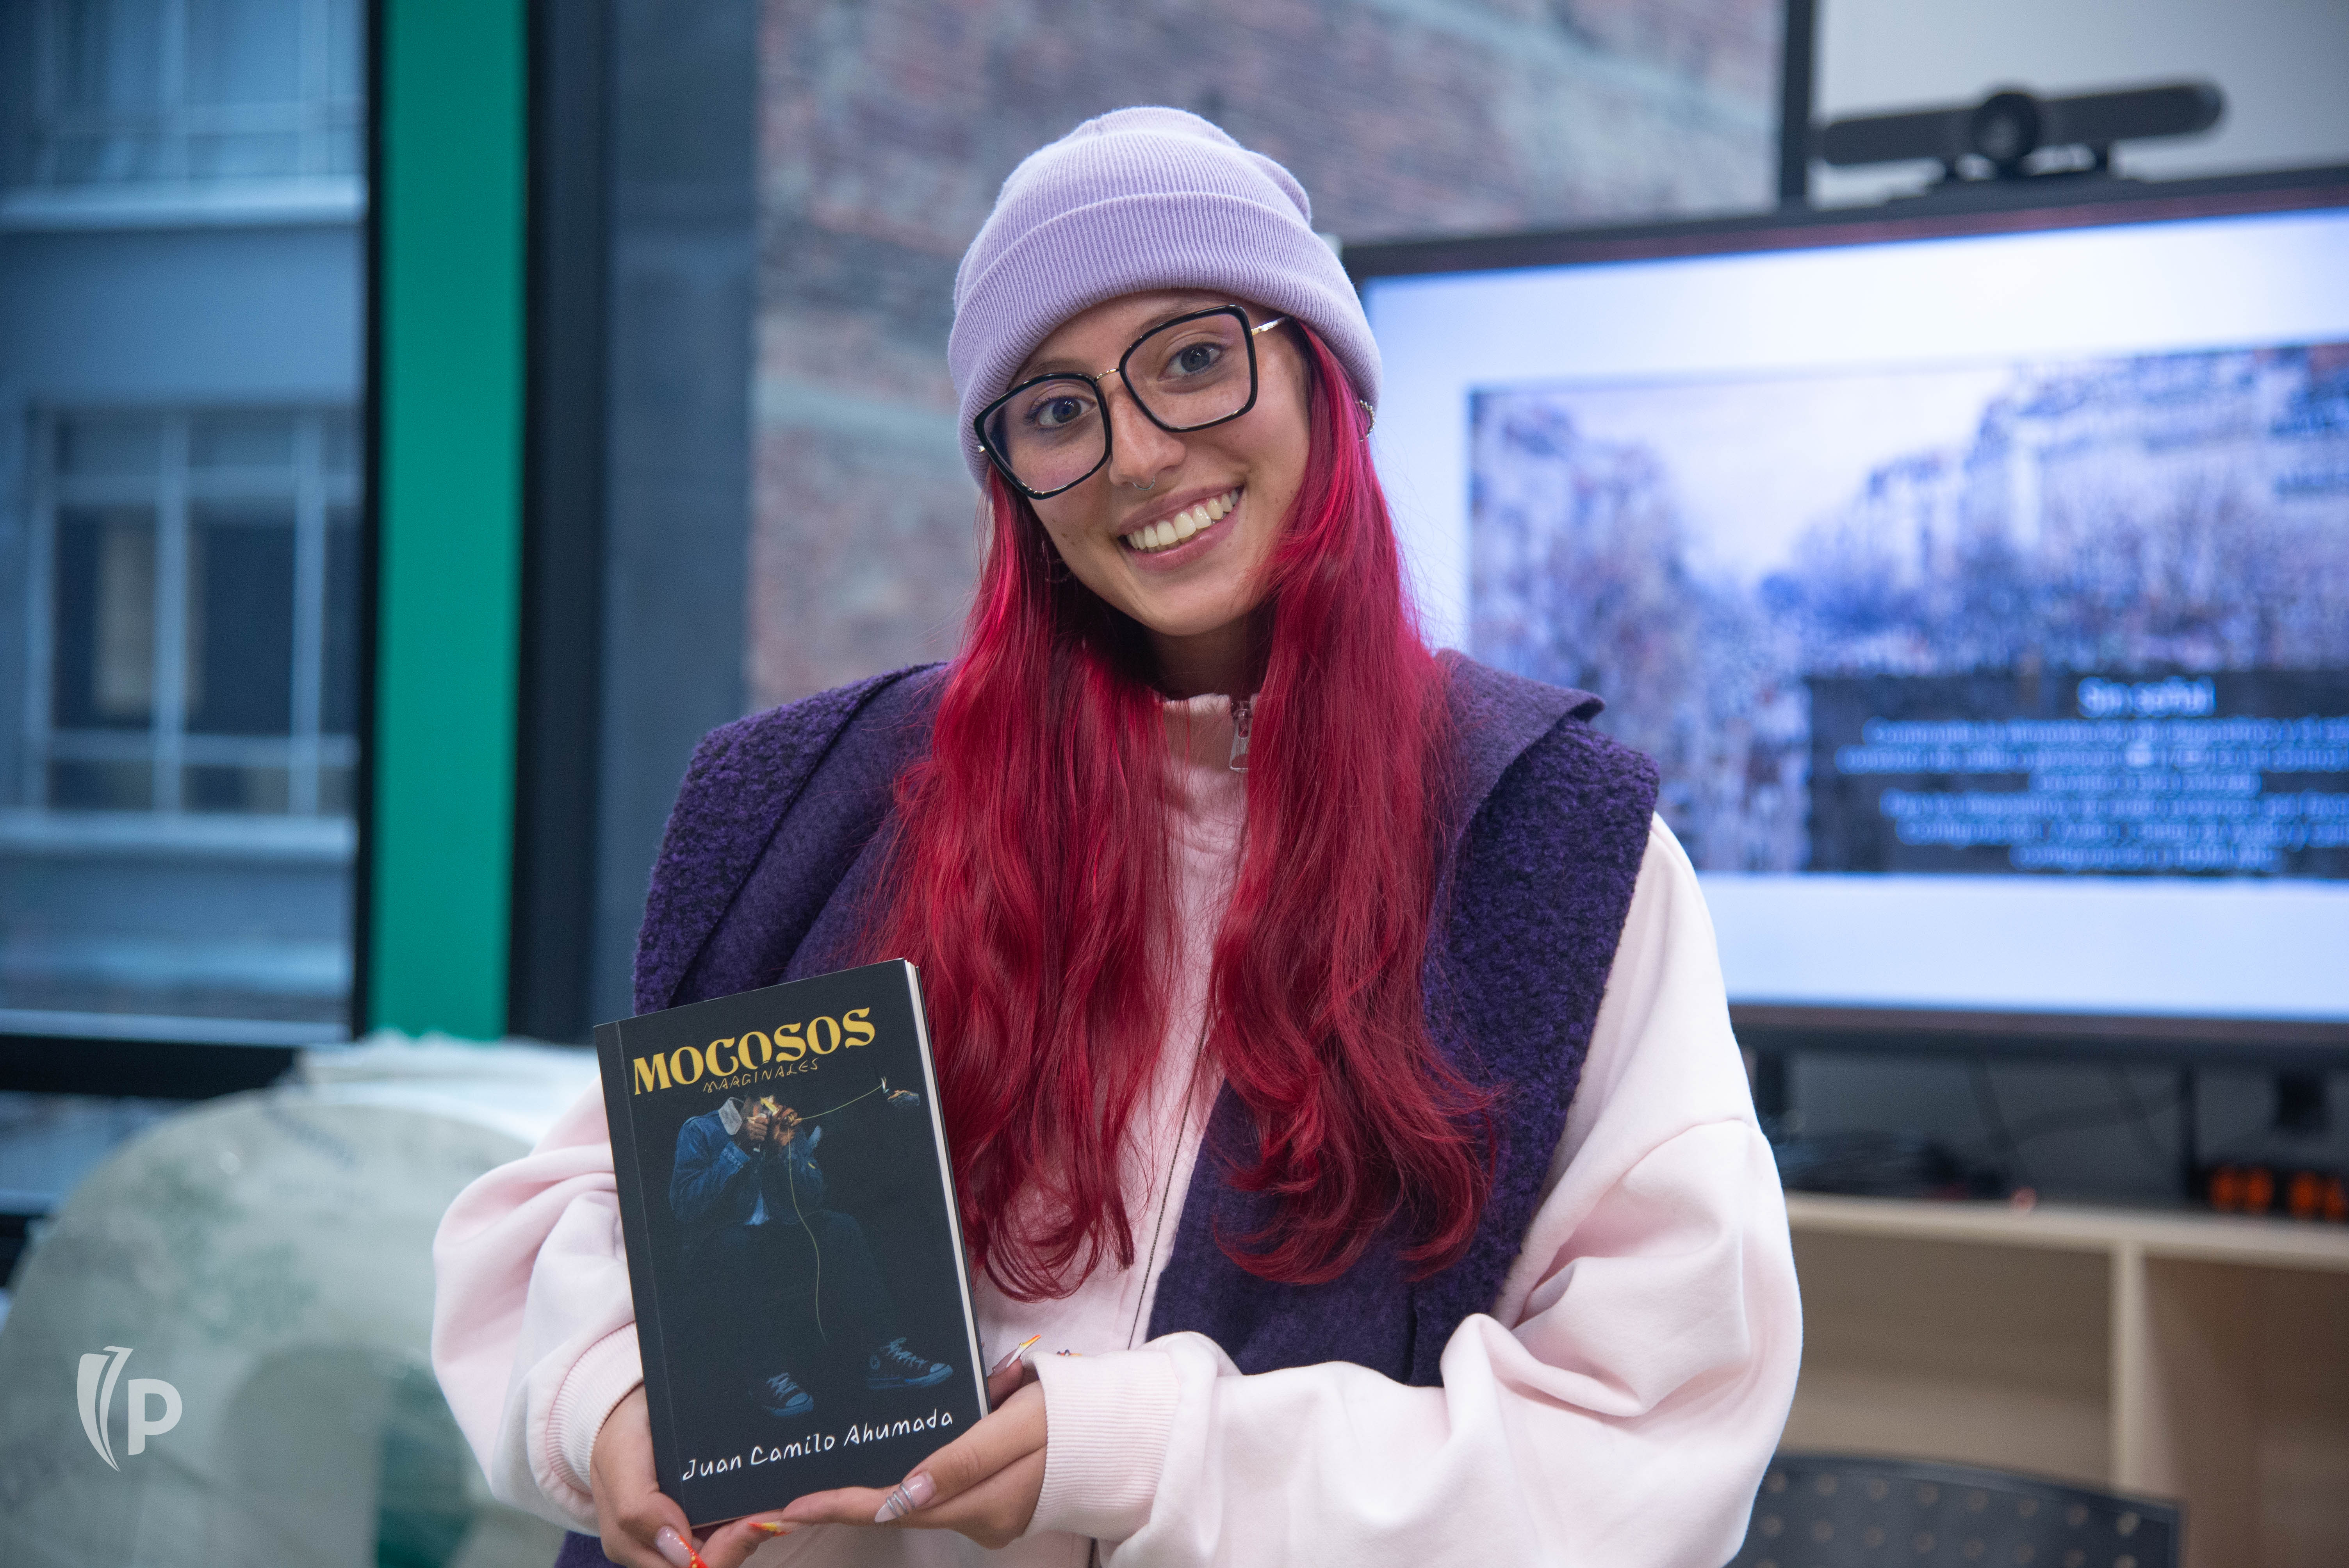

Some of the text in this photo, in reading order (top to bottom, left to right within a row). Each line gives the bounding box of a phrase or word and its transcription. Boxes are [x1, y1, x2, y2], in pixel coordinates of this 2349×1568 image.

[633, 1007, 876, 1096] MOCOSOS
[703, 1057, 819, 1093] MARGINALES
[682, 1408, 953, 1481] Juan Camilo Ahumada
